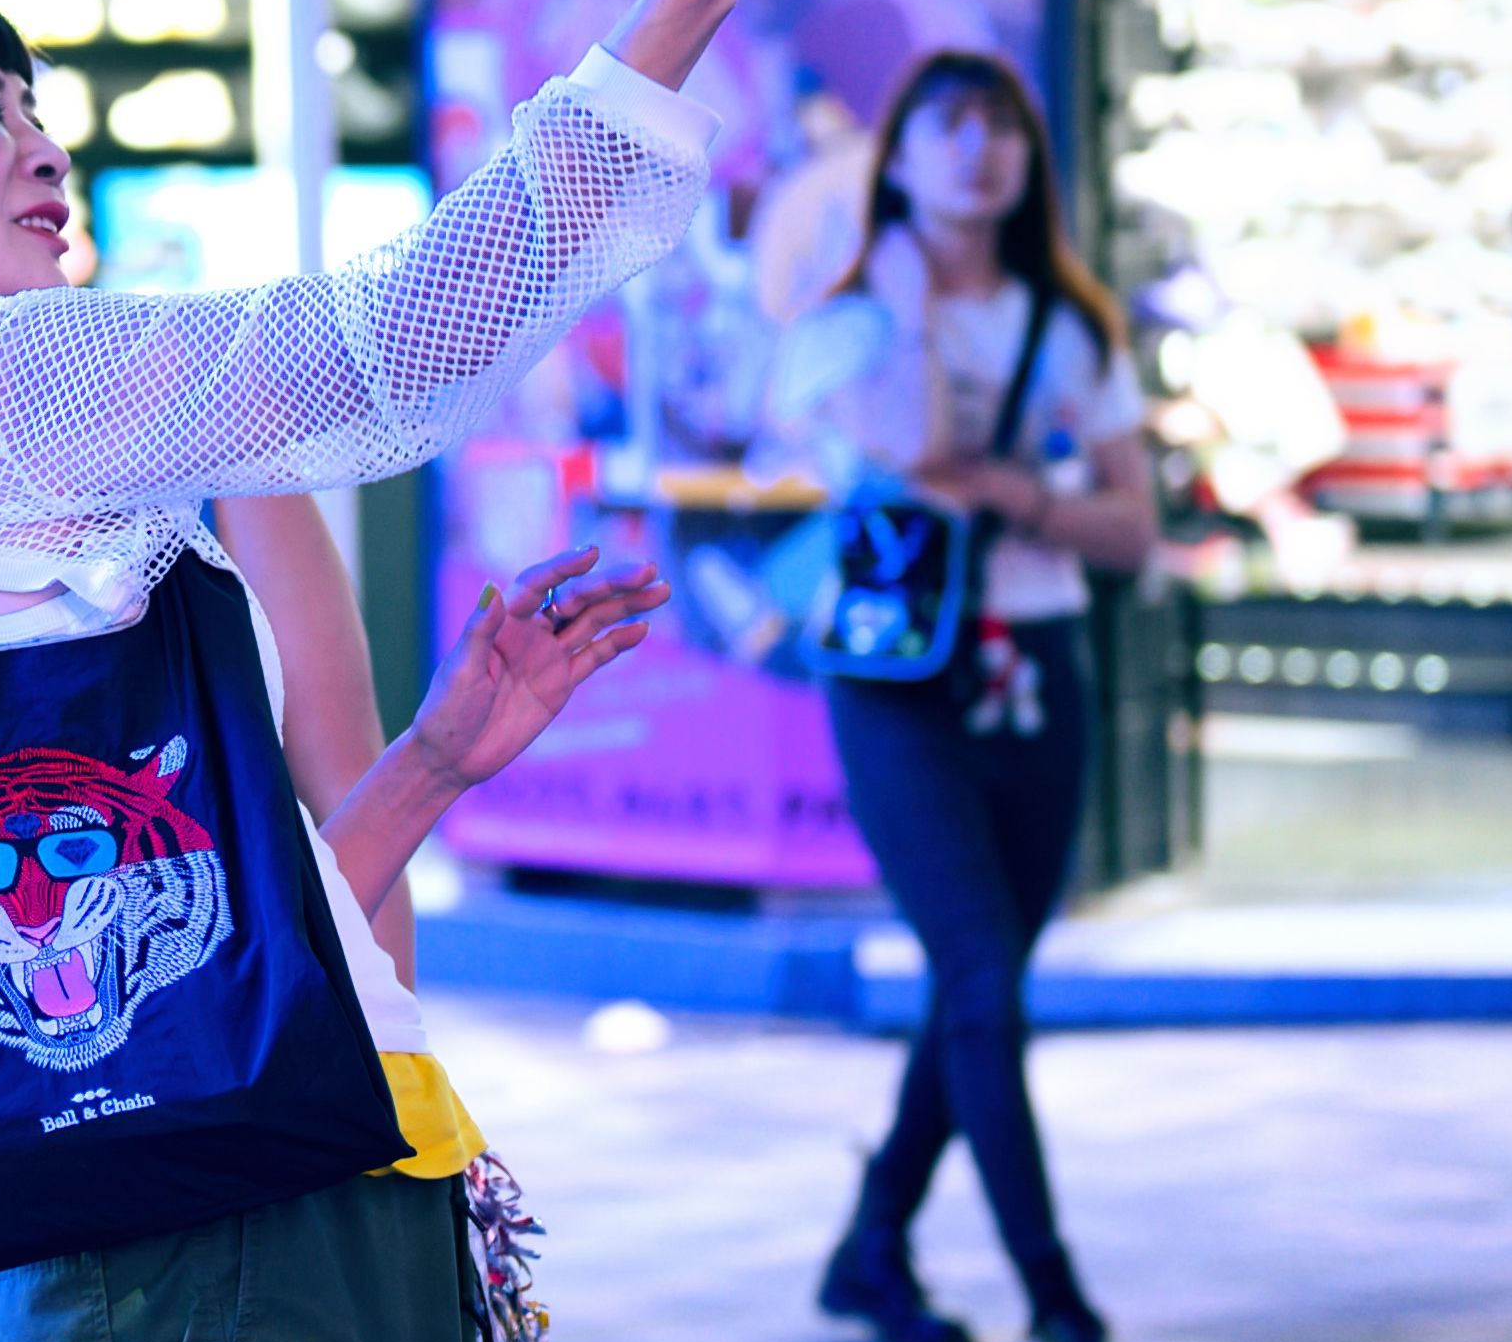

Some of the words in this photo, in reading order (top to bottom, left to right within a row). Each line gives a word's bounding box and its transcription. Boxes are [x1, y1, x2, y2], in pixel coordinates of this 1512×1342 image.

[40, 1110, 80, 1133] Ball
[83, 1107, 98, 1120] &
[100, 1093, 156, 1116] Chain
